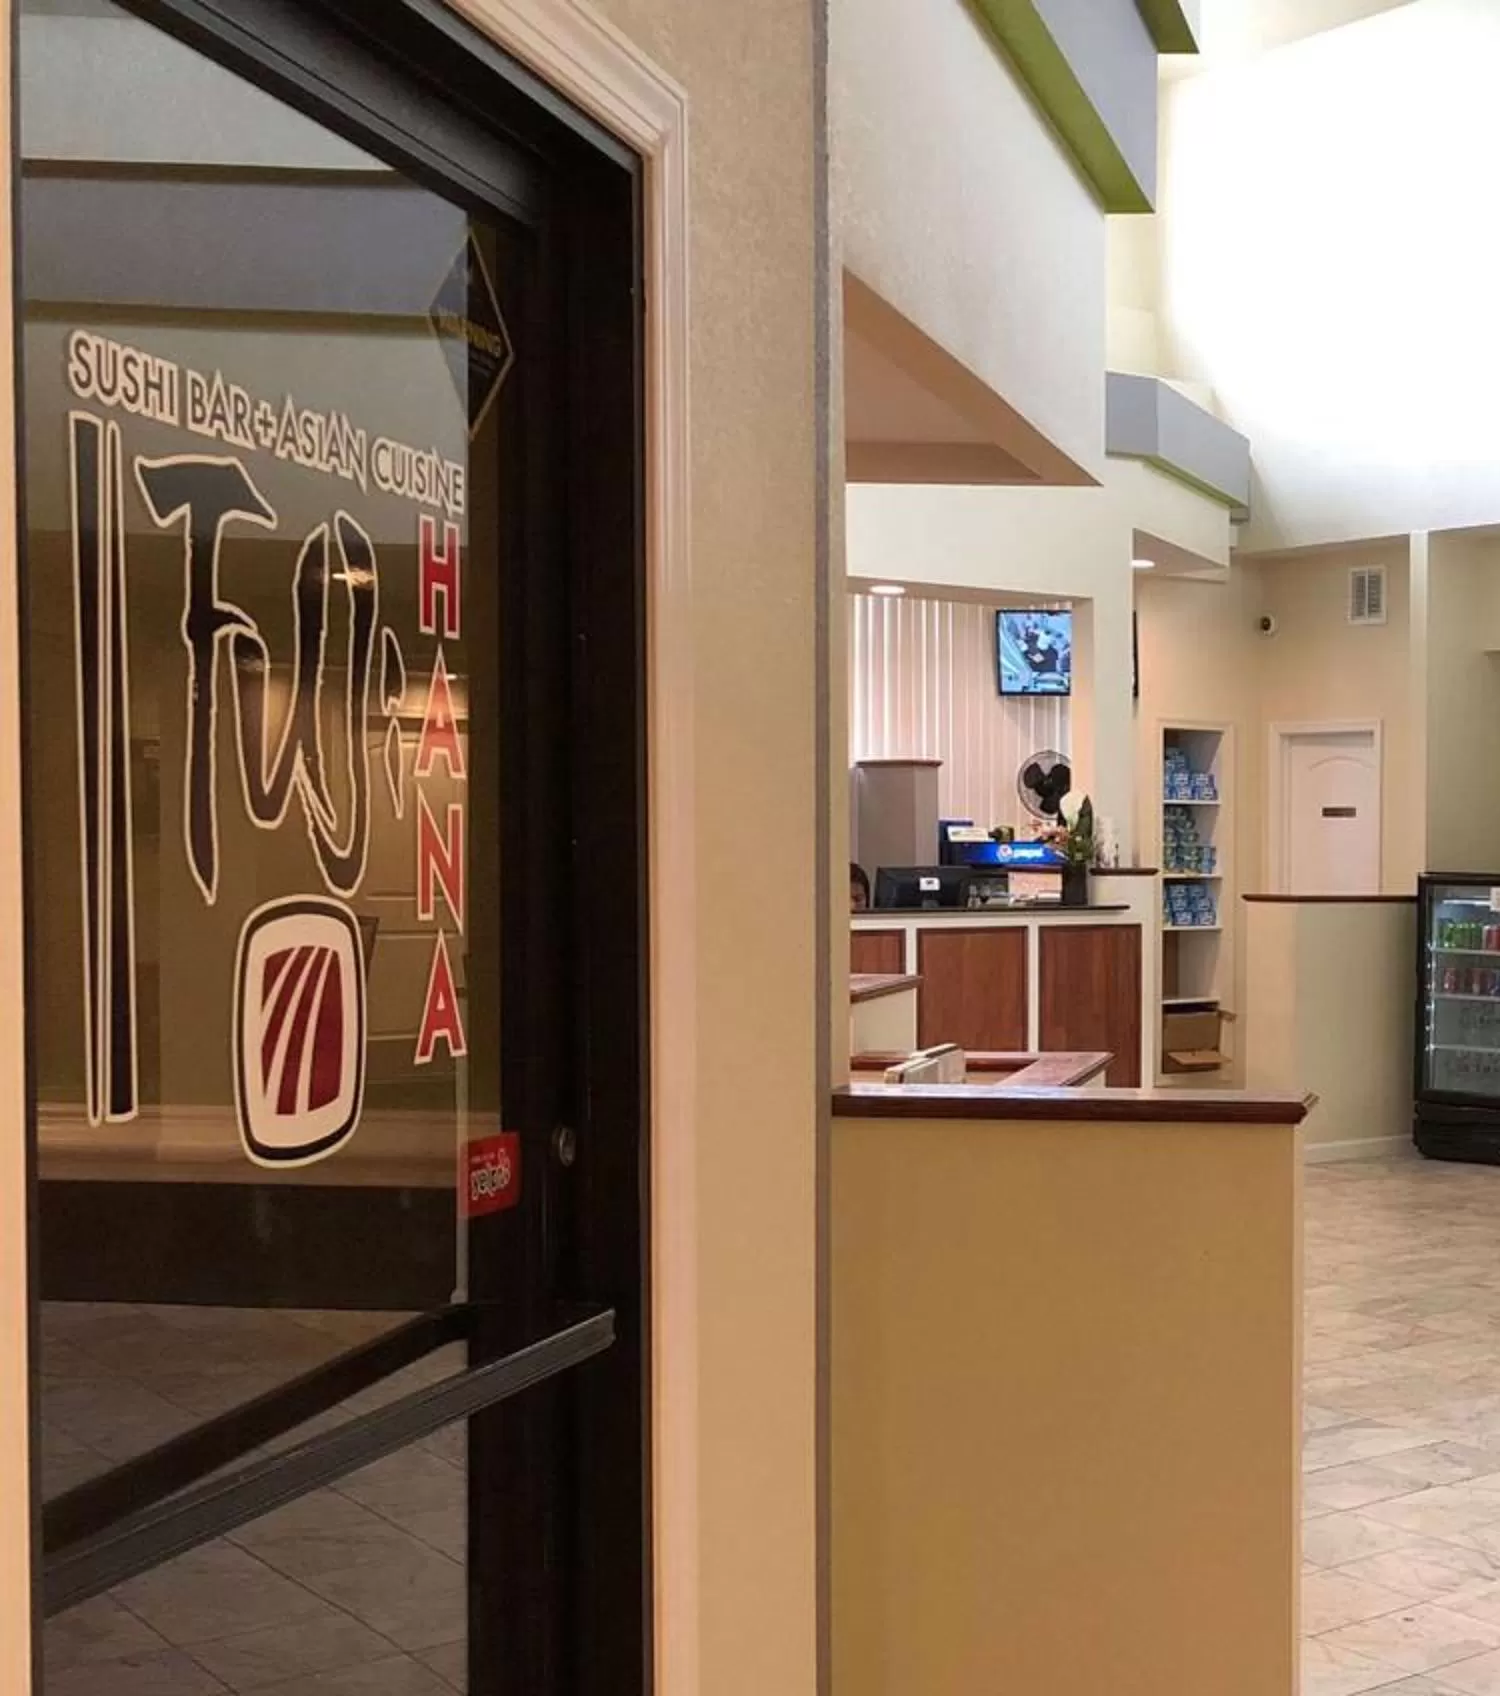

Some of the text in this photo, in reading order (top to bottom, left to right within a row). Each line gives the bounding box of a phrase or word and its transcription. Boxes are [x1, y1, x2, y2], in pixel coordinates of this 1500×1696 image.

[69, 329, 180, 427] SUSHI
[371, 436, 466, 516] CUISINE
[414, 514, 467, 1065] HANA
